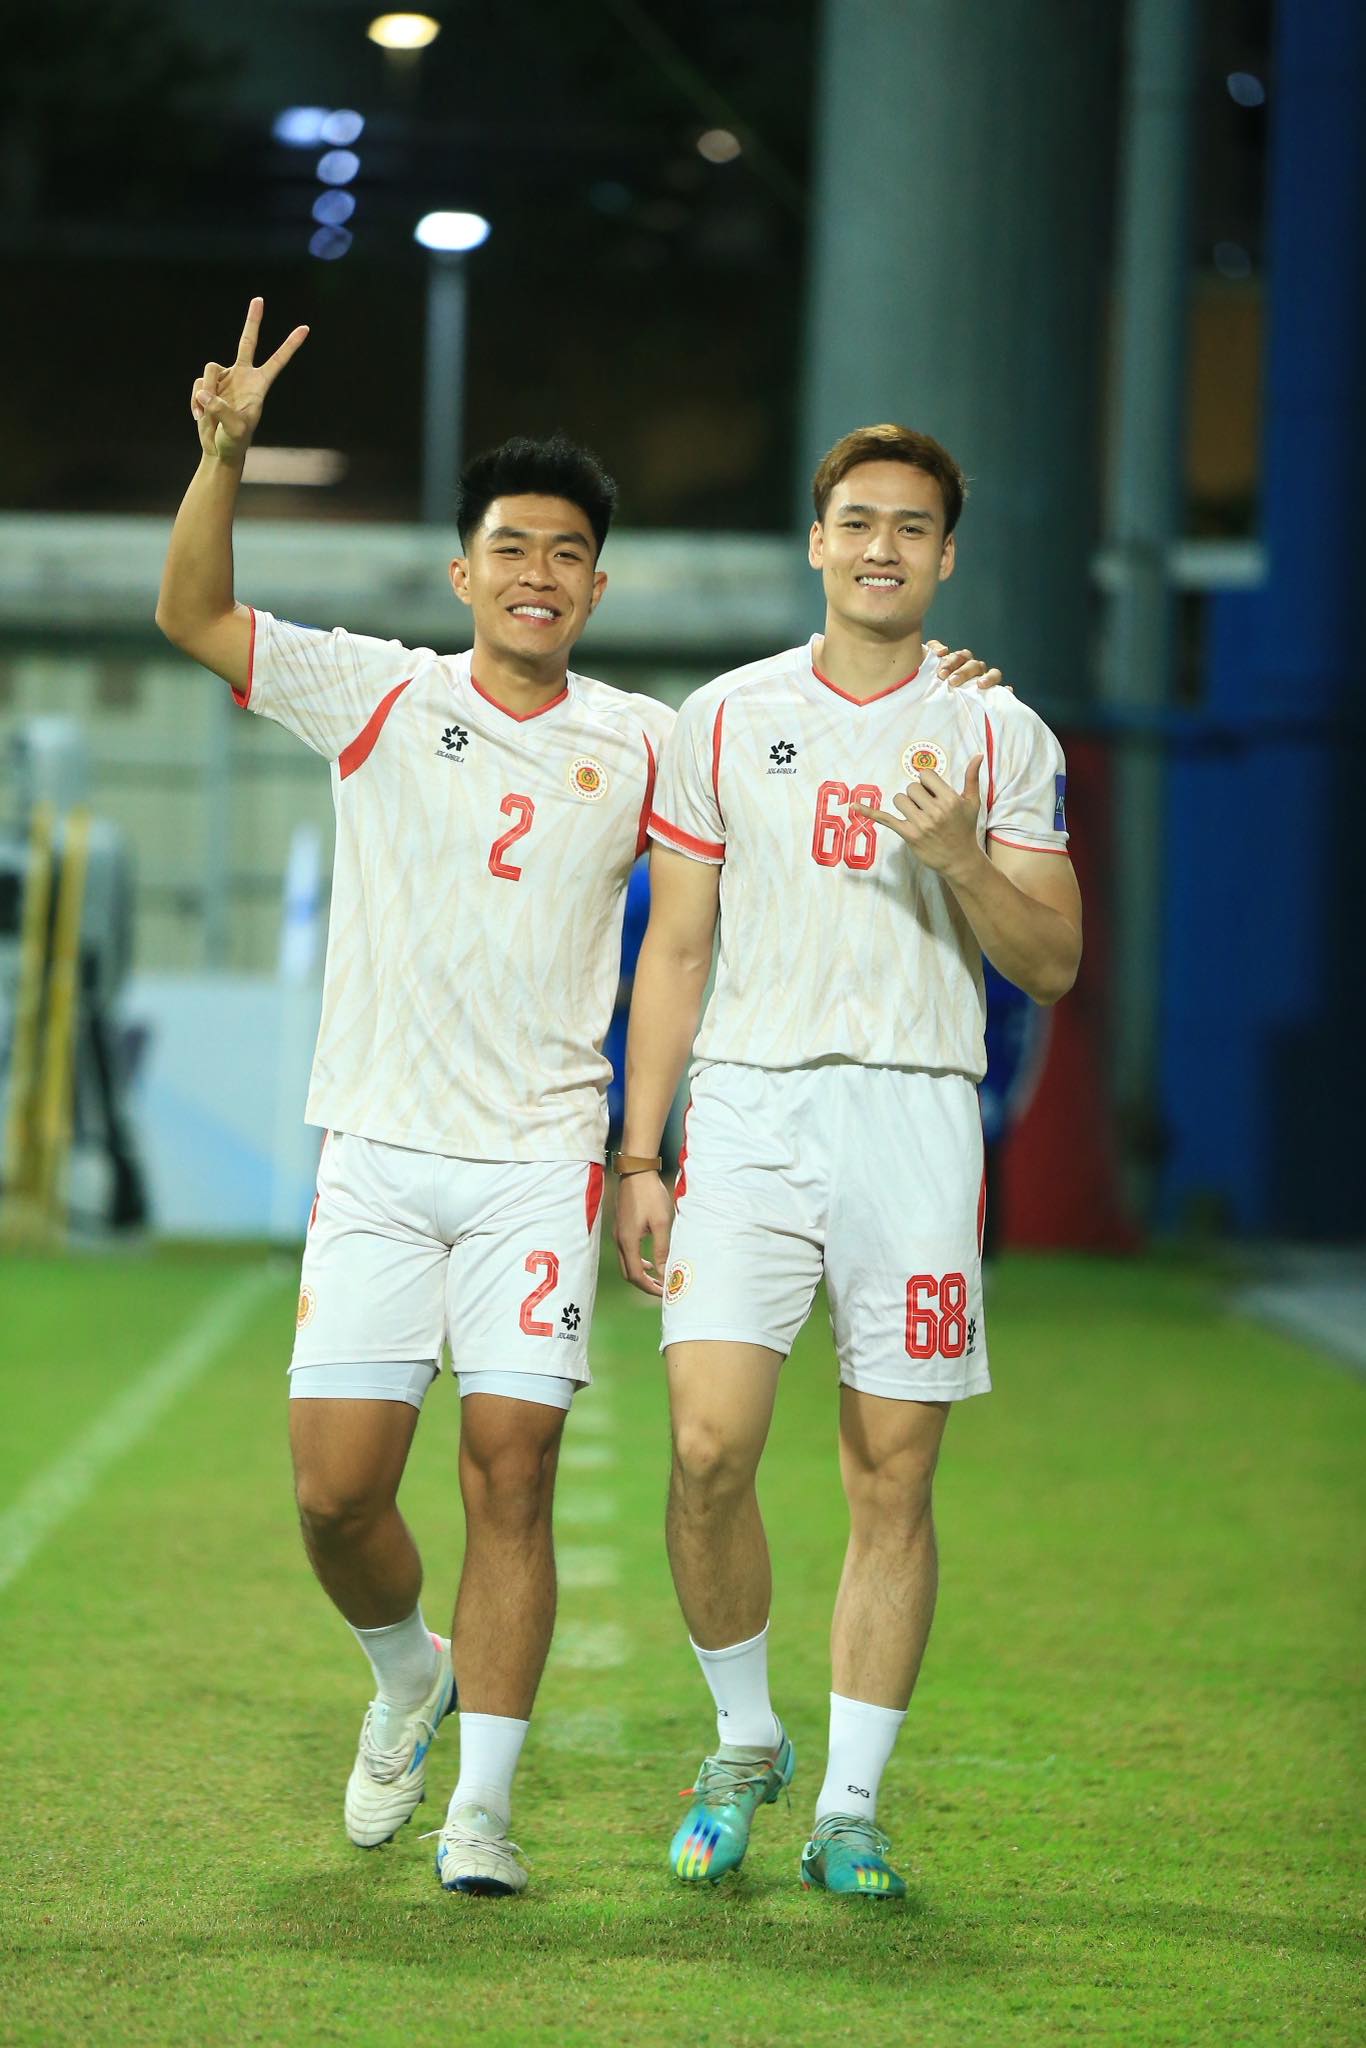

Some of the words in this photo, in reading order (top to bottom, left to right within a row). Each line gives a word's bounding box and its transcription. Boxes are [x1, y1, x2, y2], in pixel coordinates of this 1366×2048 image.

[488, 793, 535, 881] 2
[811, 780, 882, 870] 68
[519, 1250, 560, 1337] 2
[905, 1272, 967, 1360] 68
